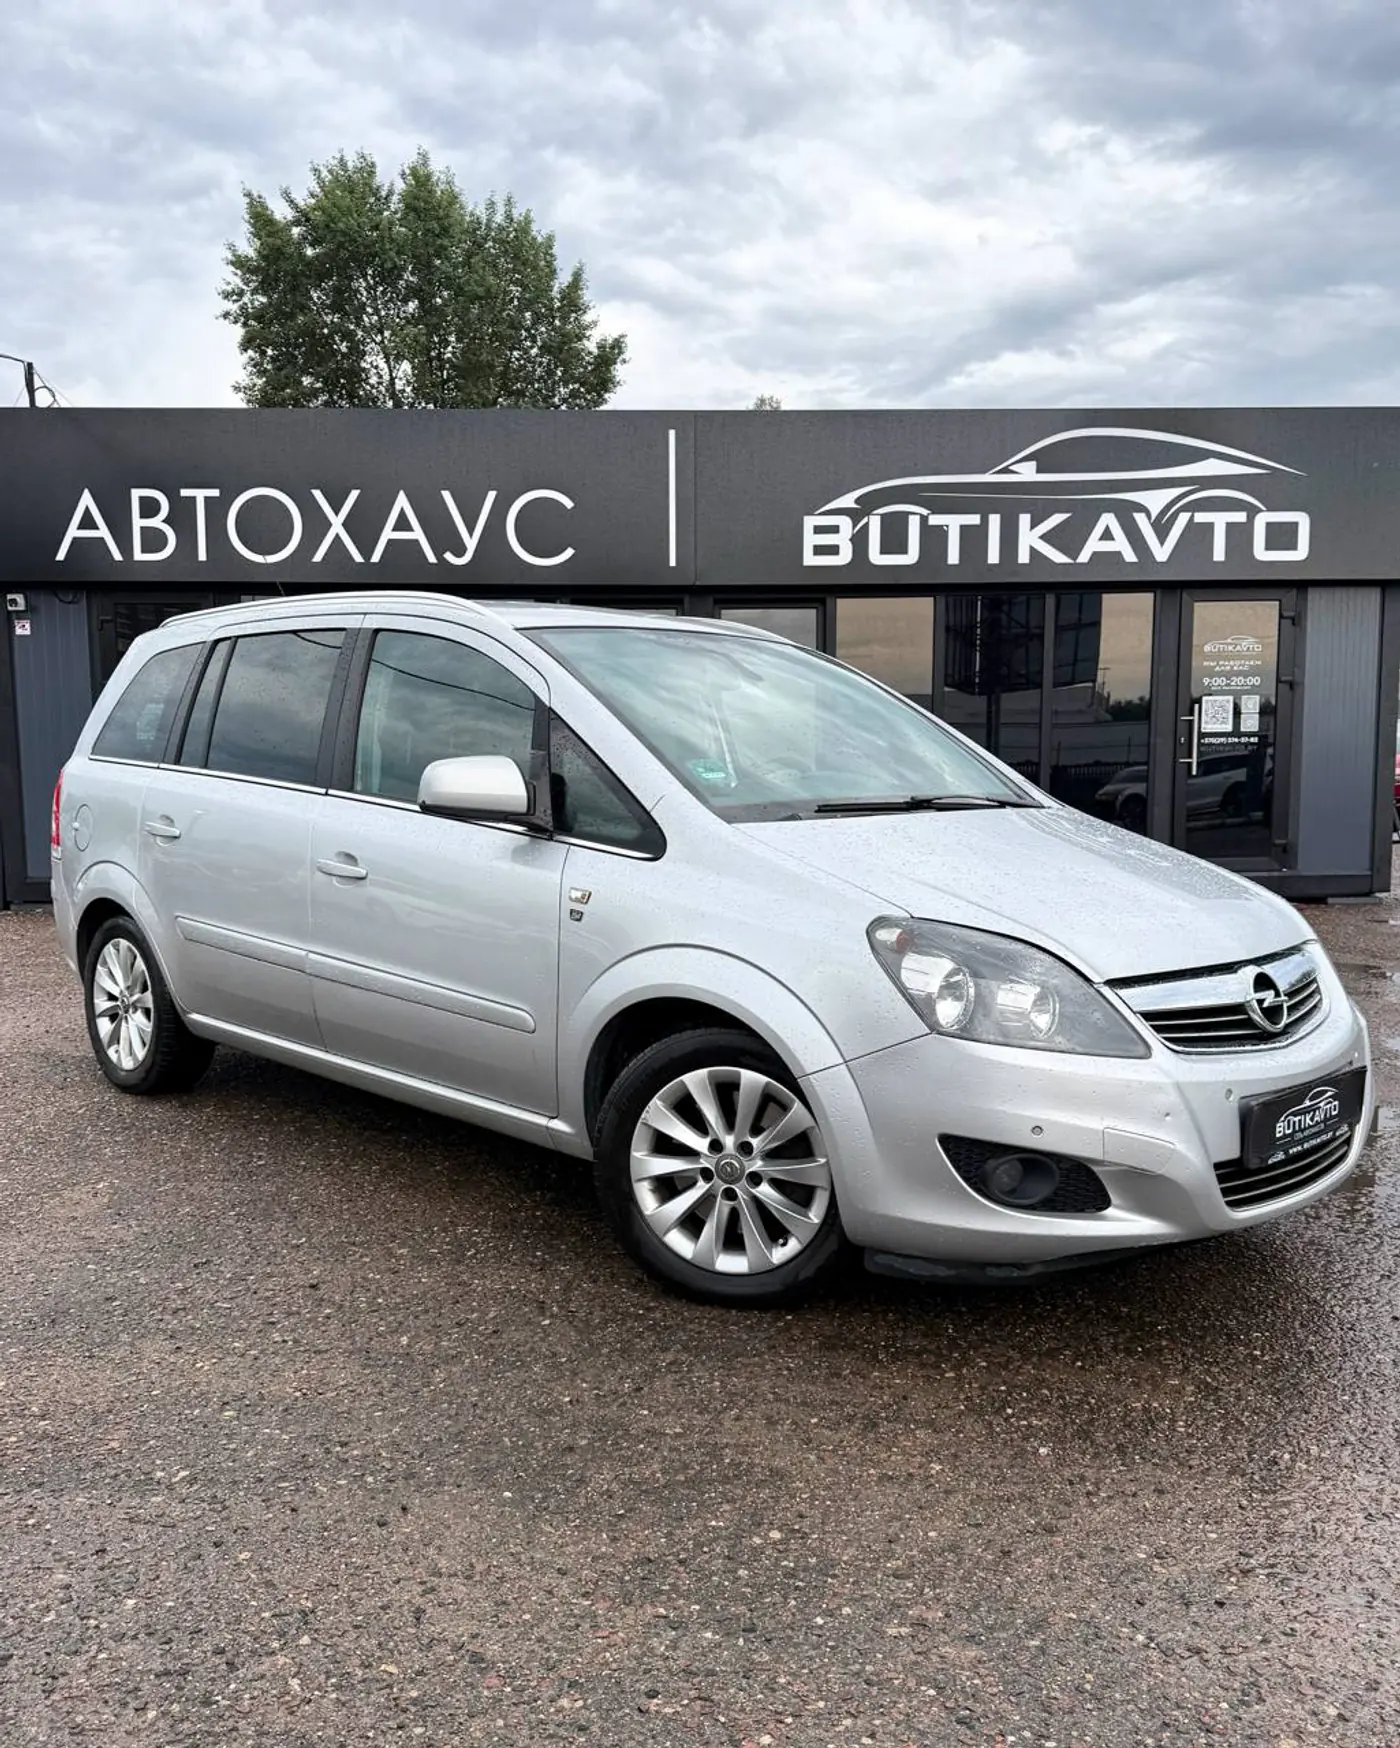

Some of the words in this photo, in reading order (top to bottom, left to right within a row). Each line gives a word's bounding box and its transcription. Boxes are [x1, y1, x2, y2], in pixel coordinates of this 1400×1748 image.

[56, 487, 575, 566] АВТОХАУС
[803, 511, 1310, 566] BUTIKAVTO
[1203, 644, 1262, 652] BUTIKAVTO
[1203, 676, 1261, 686] 9:00-20:00
[1275, 1100, 1339, 1138] BUTIKAVTO
